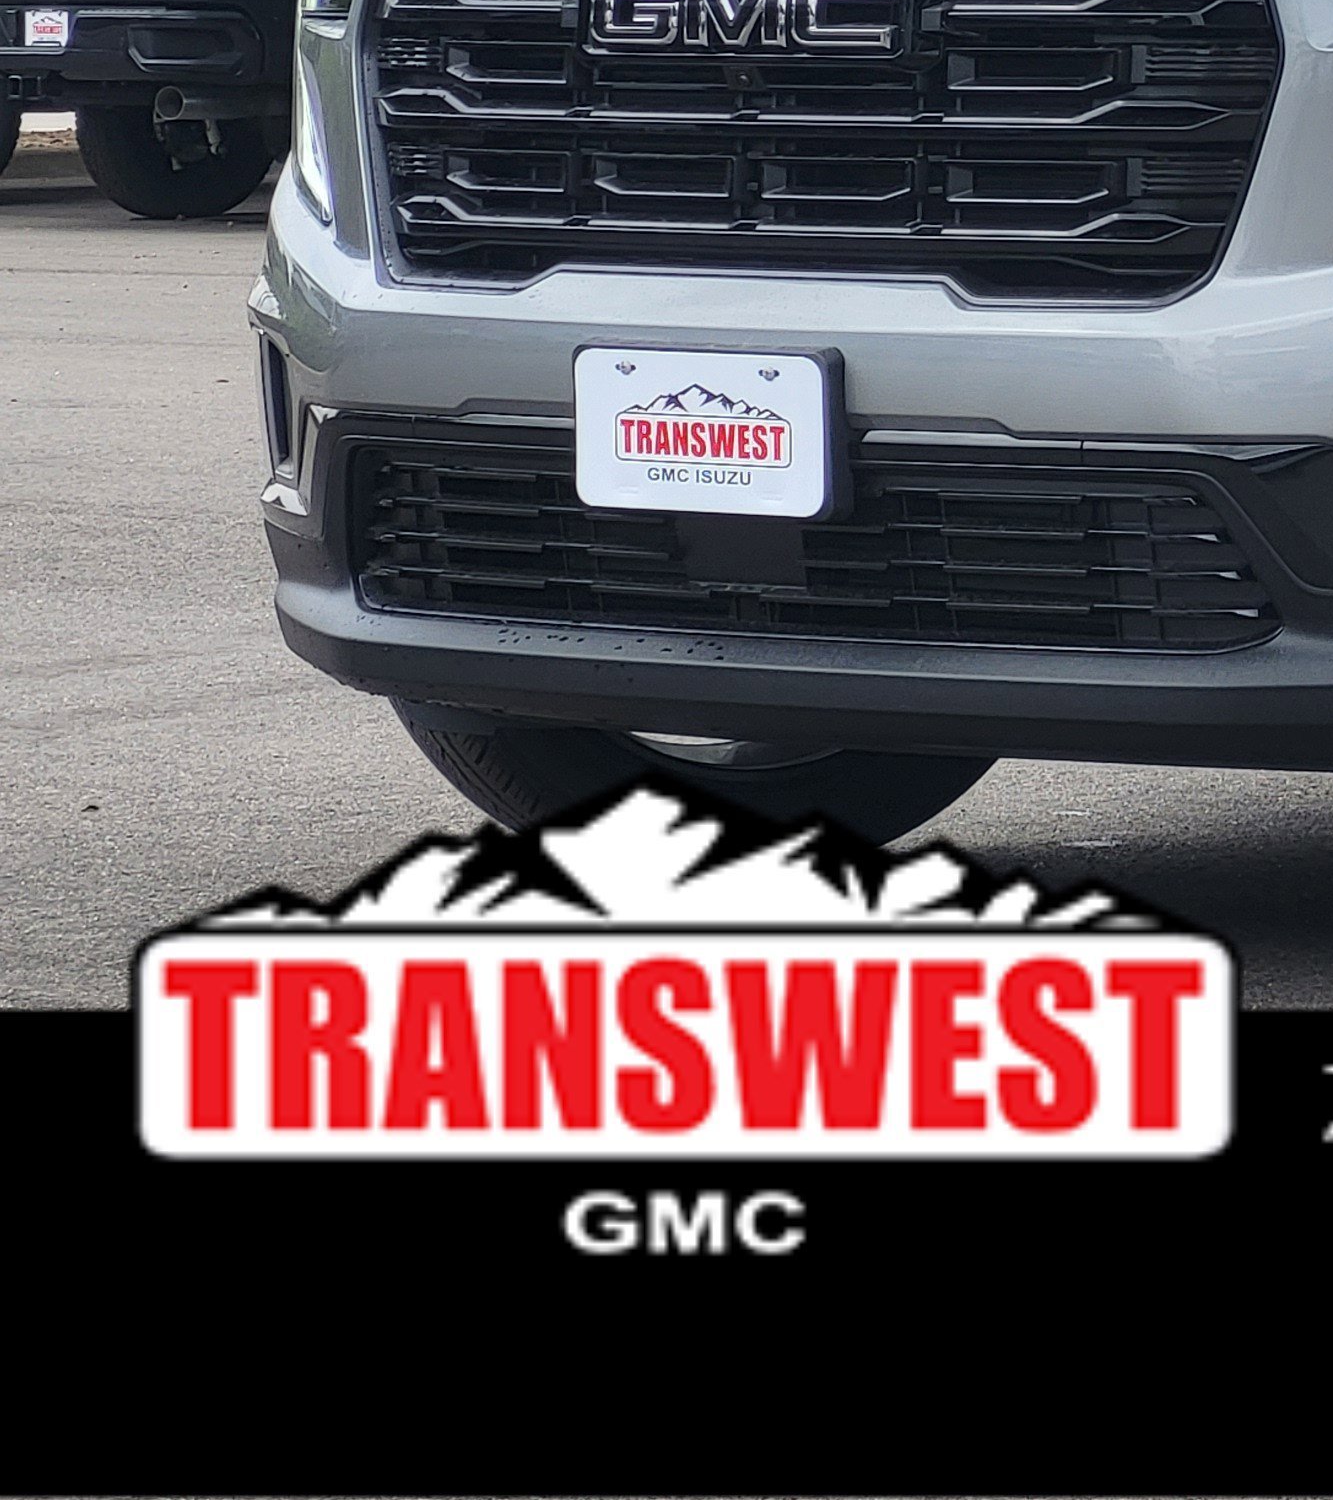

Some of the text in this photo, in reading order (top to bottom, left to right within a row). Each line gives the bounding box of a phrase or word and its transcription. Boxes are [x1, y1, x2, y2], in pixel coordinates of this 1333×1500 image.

[619, 418, 786, 462] TRANSWEST
[646, 466, 752, 486] GMC ISUZU
